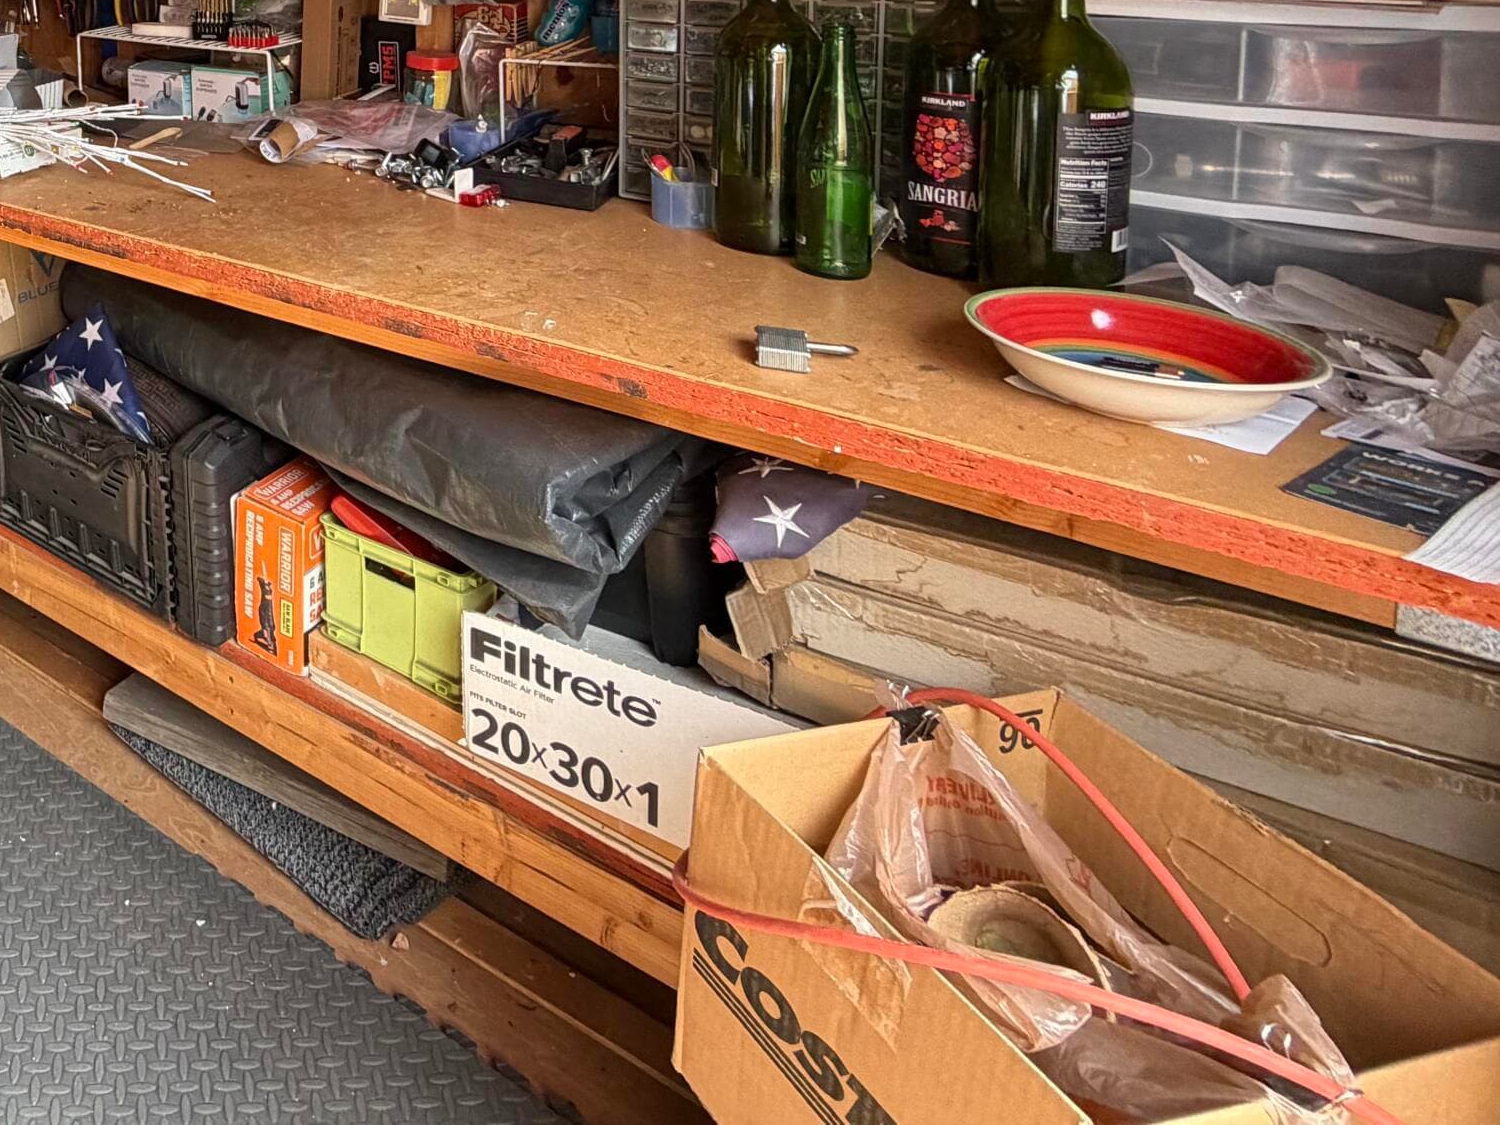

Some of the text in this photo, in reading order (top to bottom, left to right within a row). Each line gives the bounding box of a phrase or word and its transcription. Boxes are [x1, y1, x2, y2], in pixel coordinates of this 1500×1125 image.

[542, 0, 571, 42] mentos
[921, 96, 967, 108] KIRKLAND
[1089, 110, 1130, 121] KIRKLAND
[1060, 158, 1090, 166] Nutrition
[907, 179, 979, 213] SANGRIA
[1059, 180, 1107, 189] Calories 240
[261, 467, 304, 498] WARRIOR
[291, 501, 315, 517] SAW
[255, 524, 265, 547] AMP
[243, 511, 255, 619] RECIPROCATING SAW
[280, 532, 293, 594] WARRIOR
[469, 663, 555, 705] Electrostatic Air Filter
[470, 626, 658, 727] Filtrete
[469, 690, 527, 720] FITS FILTER SLOT
[695, 909, 898, 1125] COST
